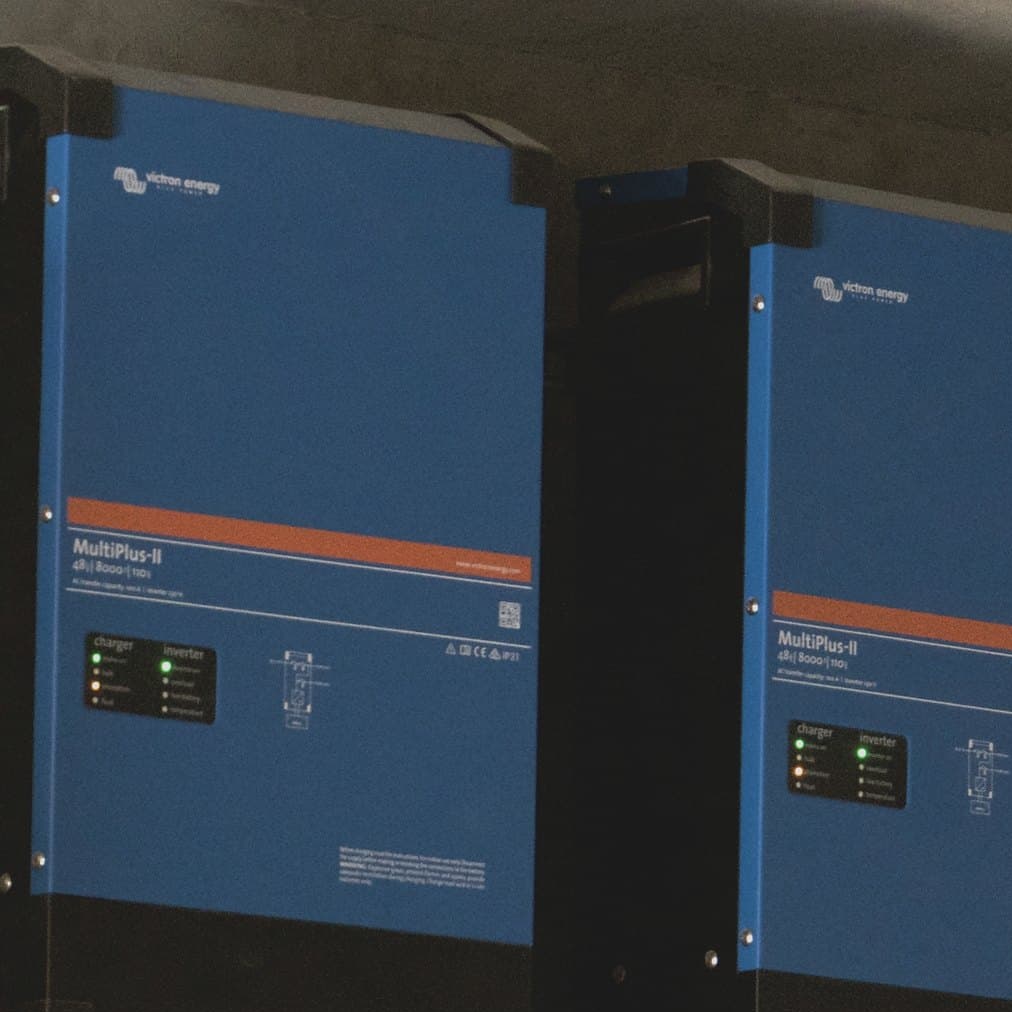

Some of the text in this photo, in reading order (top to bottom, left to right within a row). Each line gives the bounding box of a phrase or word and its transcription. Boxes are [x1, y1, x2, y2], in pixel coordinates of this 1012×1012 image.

[145, 171, 182, 187] victron
[183, 179, 220, 195] energy
[842, 280, 874, 295] victron
[875, 287, 908, 304] energy
[73, 538, 162, 565] MultiPlus-II
[94, 636, 134, 653] charger
[163, 645, 204, 660] inverter
[778, 630, 858, 656] MultiPlus-II
[797, 723, 833, 740] charger
[860, 732, 896, 747] inverter
